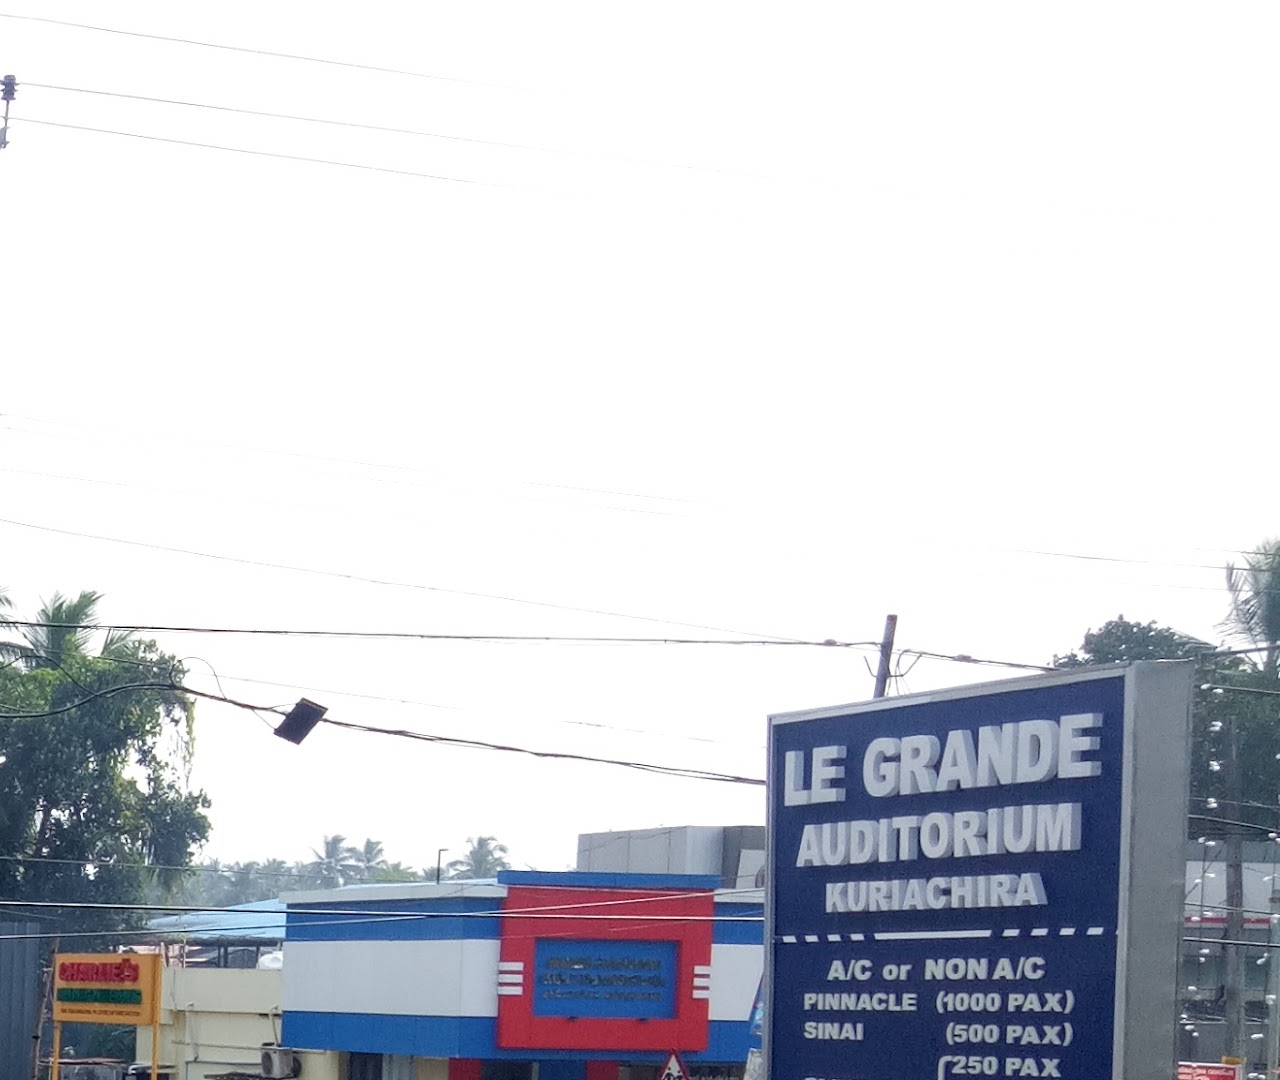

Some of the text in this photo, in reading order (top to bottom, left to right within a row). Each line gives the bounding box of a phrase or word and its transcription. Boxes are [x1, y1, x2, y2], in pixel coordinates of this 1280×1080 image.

[784, 713, 1103, 806] LE GRANDE
[796, 802, 1082, 867] AUDITORIUM
[825, 873, 1048, 913] KURIACHIRA
[827, 957, 1045, 981] A/C or NON A/C
[803, 990, 1075, 1014] PINNACLE (1000 PAX)
[803, 1022, 1073, 1047] SINAI (500 PAX)
[951, 1056, 1061, 1078] 250 PAX
